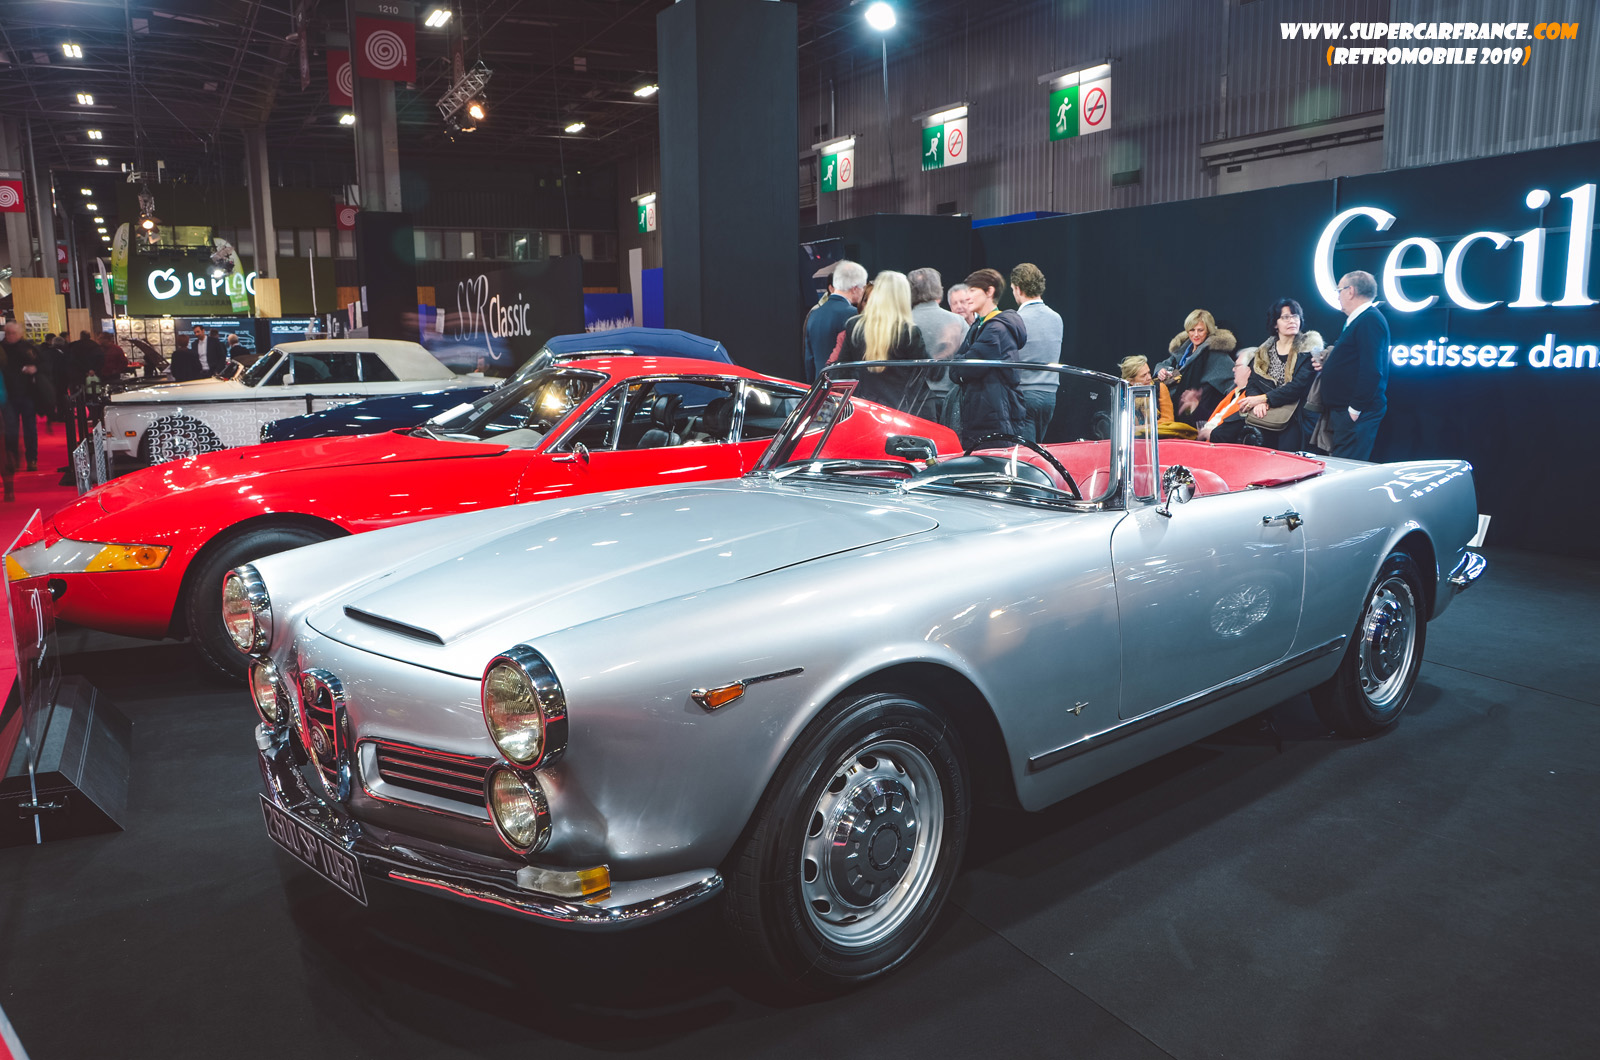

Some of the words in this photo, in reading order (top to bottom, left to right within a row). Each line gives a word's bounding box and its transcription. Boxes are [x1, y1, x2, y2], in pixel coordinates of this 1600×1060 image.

[378, 5, 399, 15] 1210
[1314, 183, 1599, 313] Cecil
[187, 271, 206, 297] La
[454, 274, 502, 361] SSR
[489, 292, 531, 339] Classic
[1388, 336, 1518, 367] estissez
[1528, 333, 1600, 368] dan
[264, 803, 302, 856] 2600
